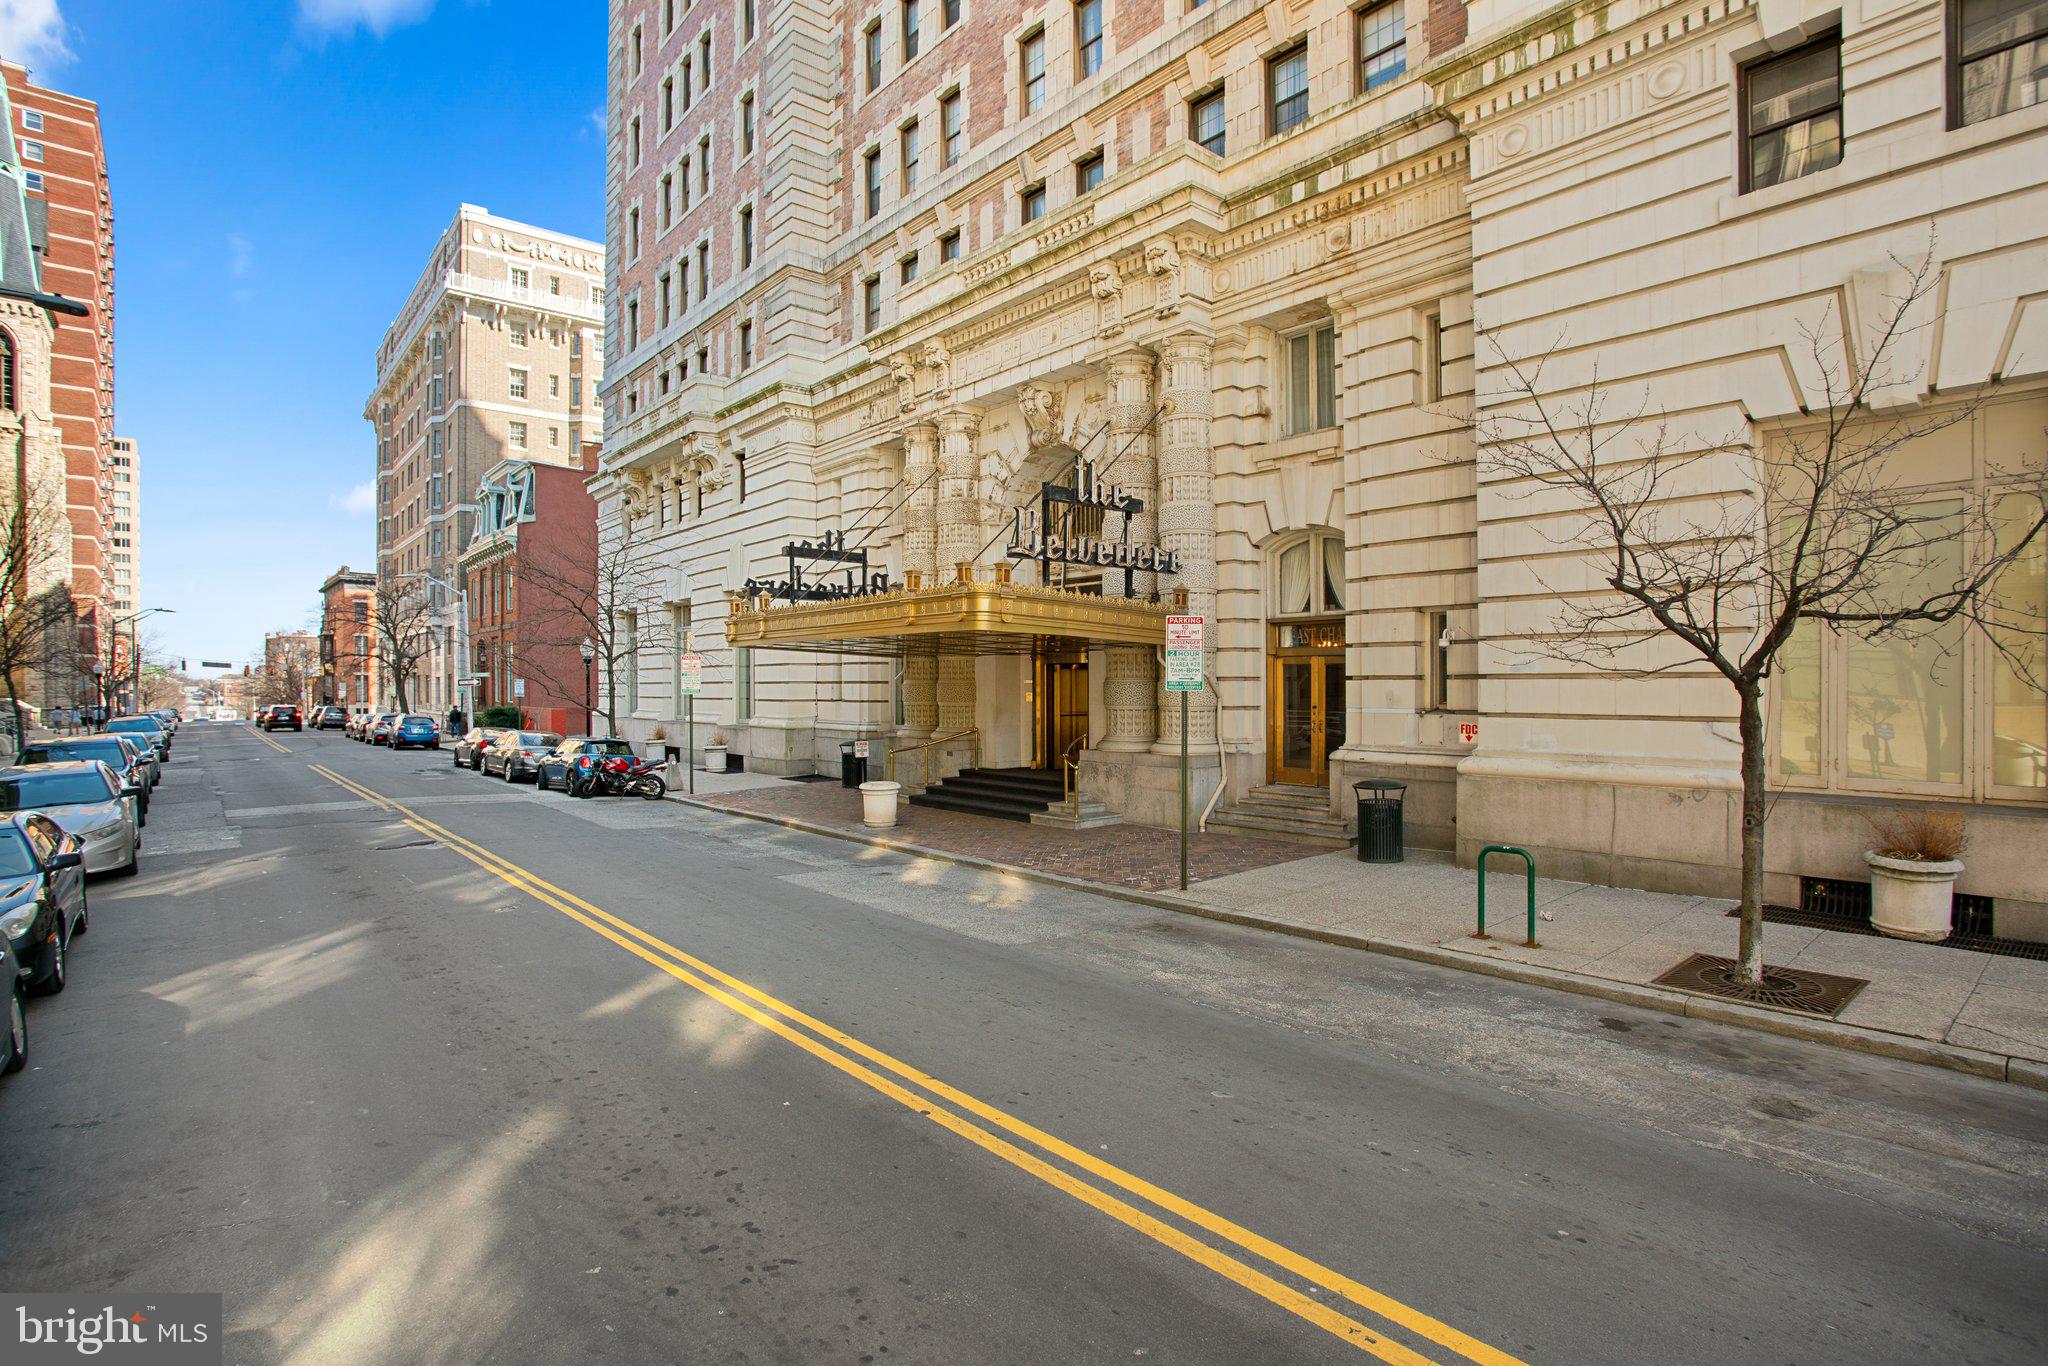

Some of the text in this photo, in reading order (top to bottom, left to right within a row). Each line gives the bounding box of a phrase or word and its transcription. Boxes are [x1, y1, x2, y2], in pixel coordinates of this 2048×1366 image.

[1074, 454, 1130, 509] the
[1006, 505, 1184, 574] Belvedere
[1292, 628, 1316, 647] AST
[1460, 724, 1478, 735] FDC
